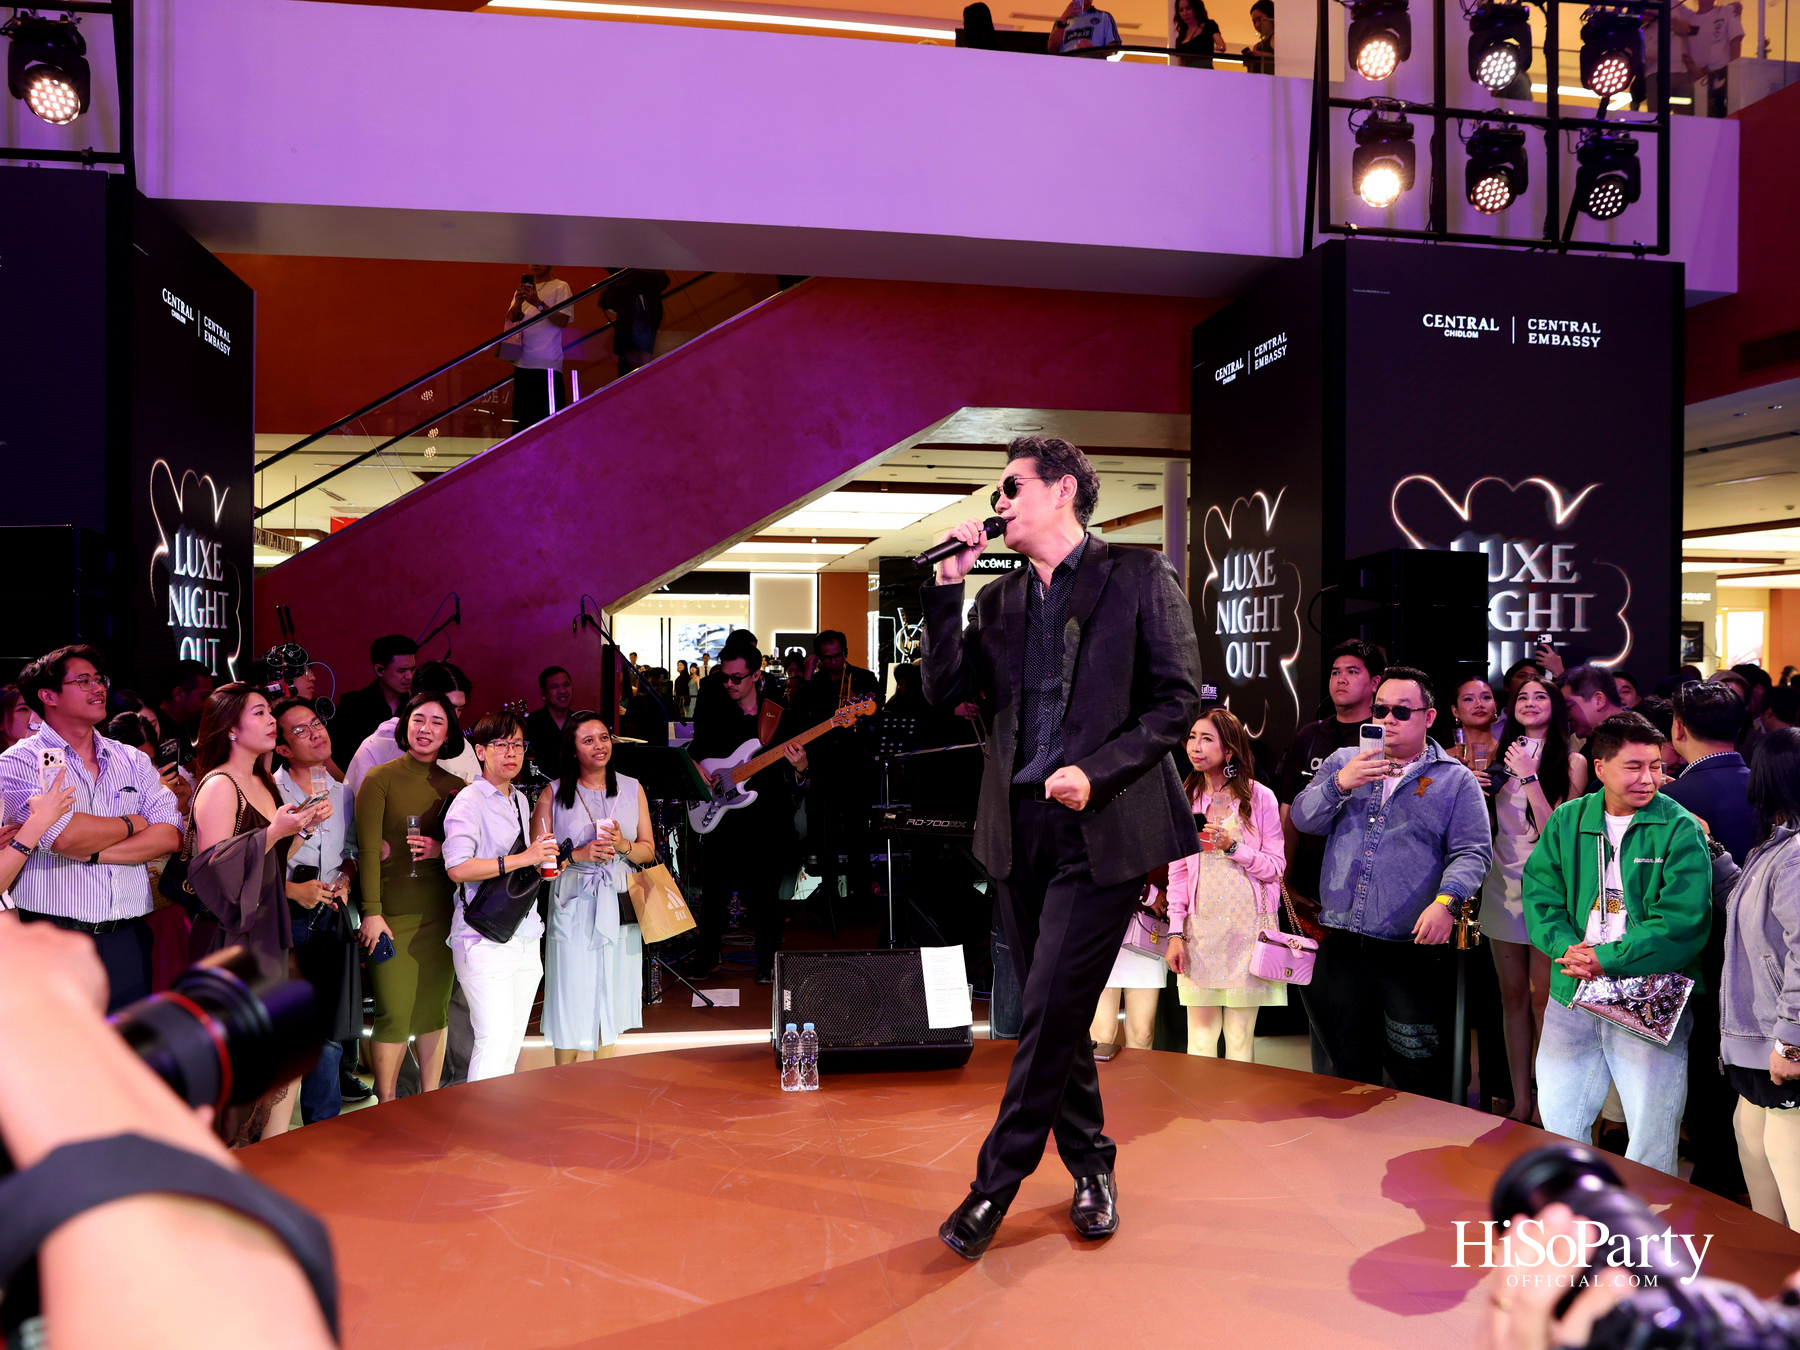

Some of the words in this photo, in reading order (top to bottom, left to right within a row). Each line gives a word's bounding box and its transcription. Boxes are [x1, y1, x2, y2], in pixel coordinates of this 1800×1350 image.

[162, 287, 194, 321] CENTRAL
[203, 316, 231, 343] CENTRAL
[1422, 313, 1500, 331] CENTRAL
[1443, 329, 1479, 339] CHIDLOM
[1527, 318, 1601, 334] CENTRAL
[203, 329, 231, 356] EMBASSY
[1254, 331, 1288, 357] CENTRAL
[1528, 332, 1602, 348] EMBASSY
[1214, 357, 1245, 381] CENTRAL
[1254, 344, 1287, 370] EMBASSY
[173, 532, 224, 581] LUXE
[1221, 547, 1277, 593] LUXE
[1450, 541, 1582, 583] UXE
[167, 583, 230, 630] NIGHT
[1214, 594, 1285, 635] NIGHT
[1488, 590, 1596, 633] GHT
[1225, 641, 1271, 679] OUT
[674, 909, 688, 921] BKK
